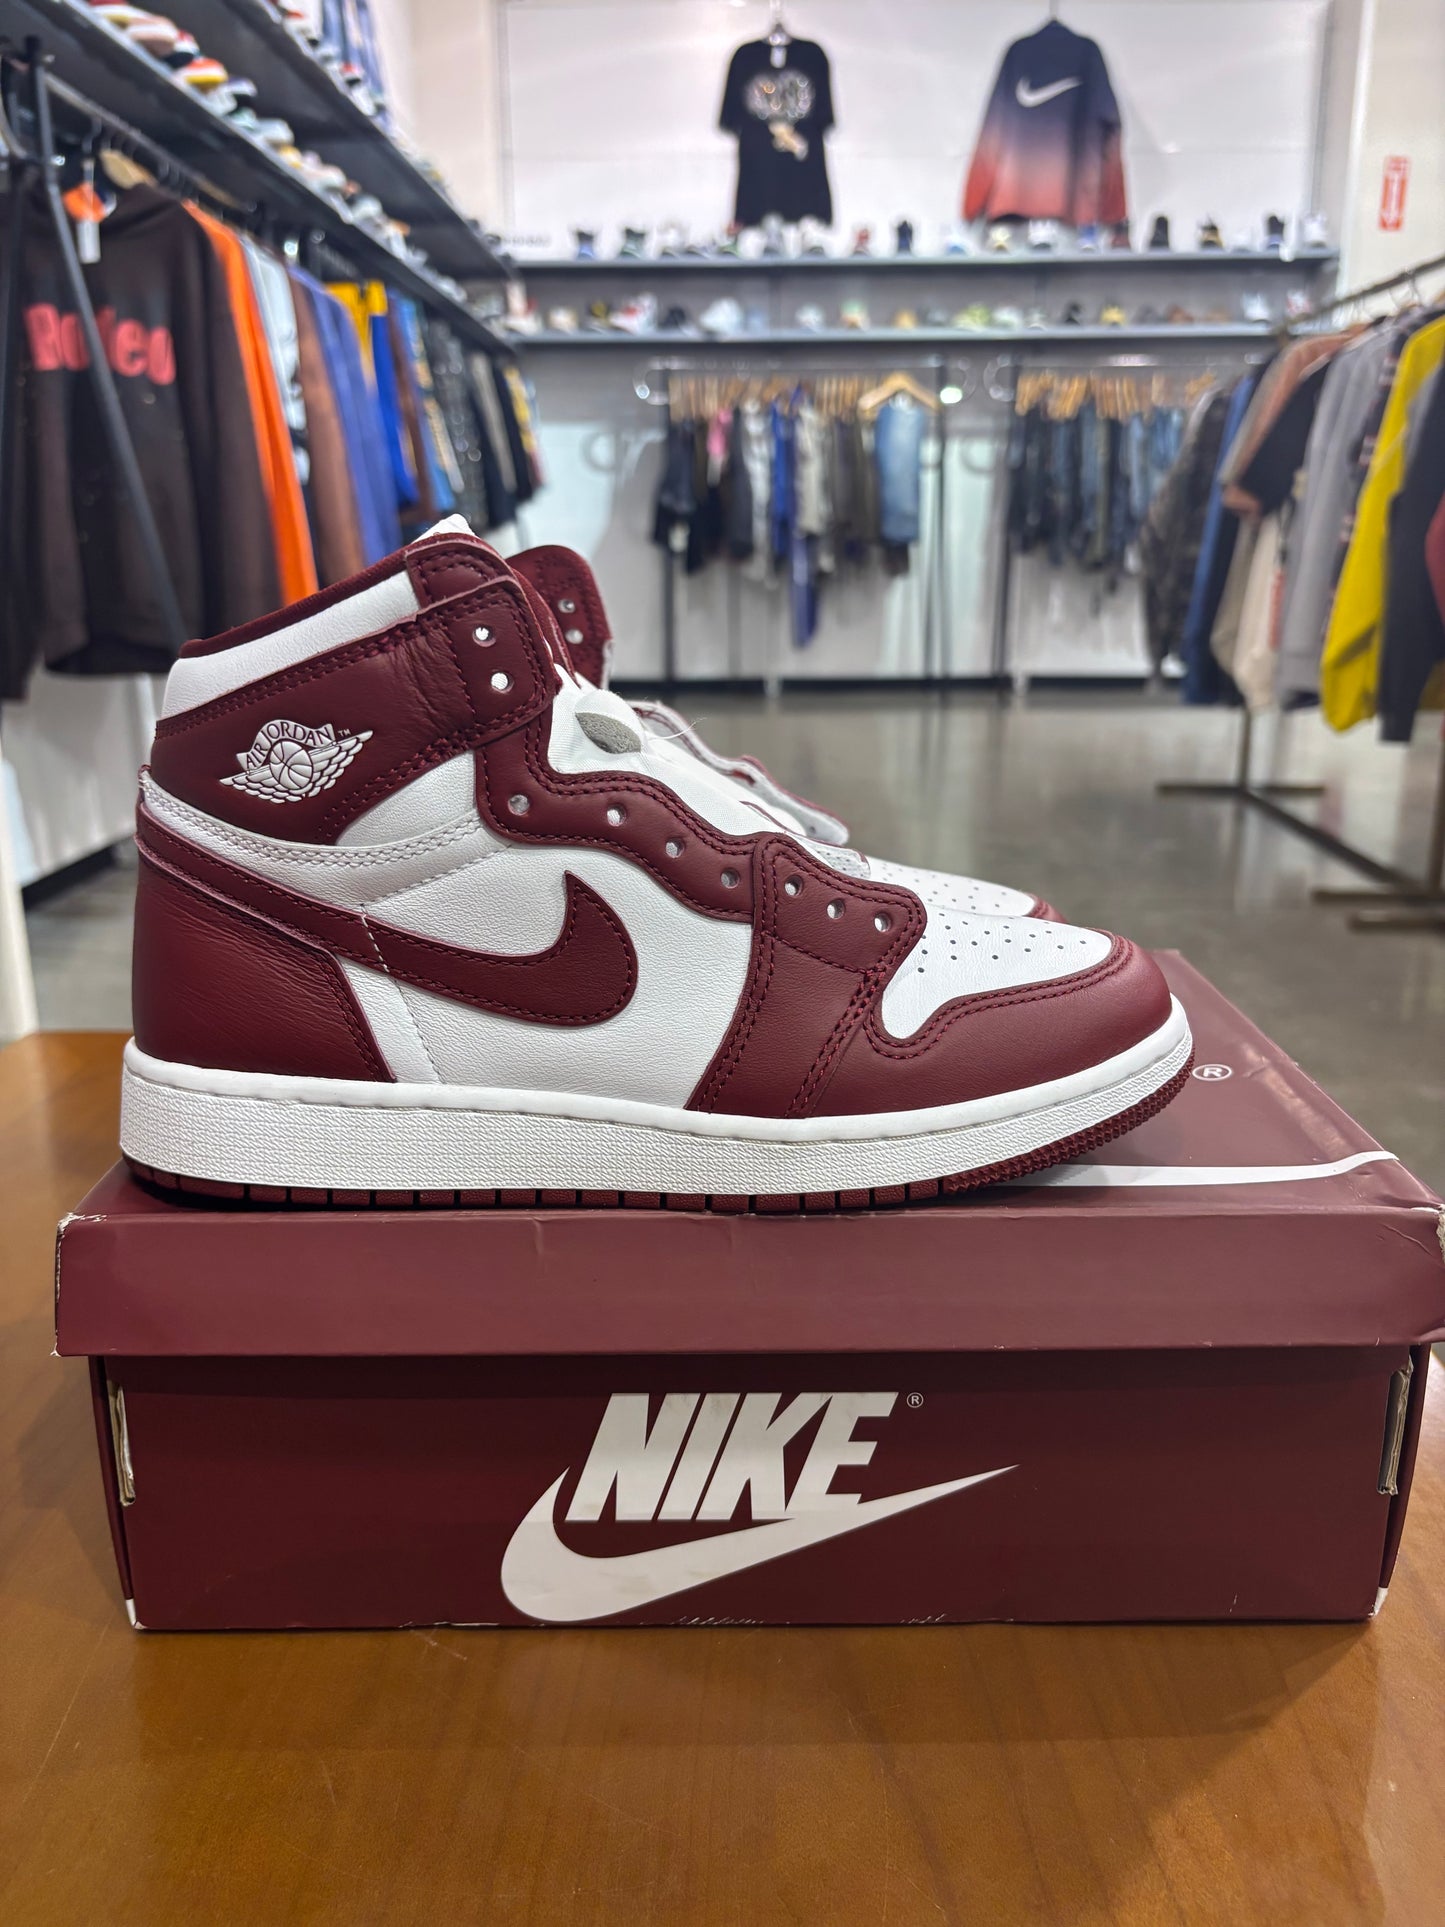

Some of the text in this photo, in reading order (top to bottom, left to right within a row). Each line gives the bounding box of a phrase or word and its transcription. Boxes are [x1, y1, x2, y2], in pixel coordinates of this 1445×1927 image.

[245, 721, 332, 770] AIR JORDAN
[564, 1391, 900, 1522] NIKE
